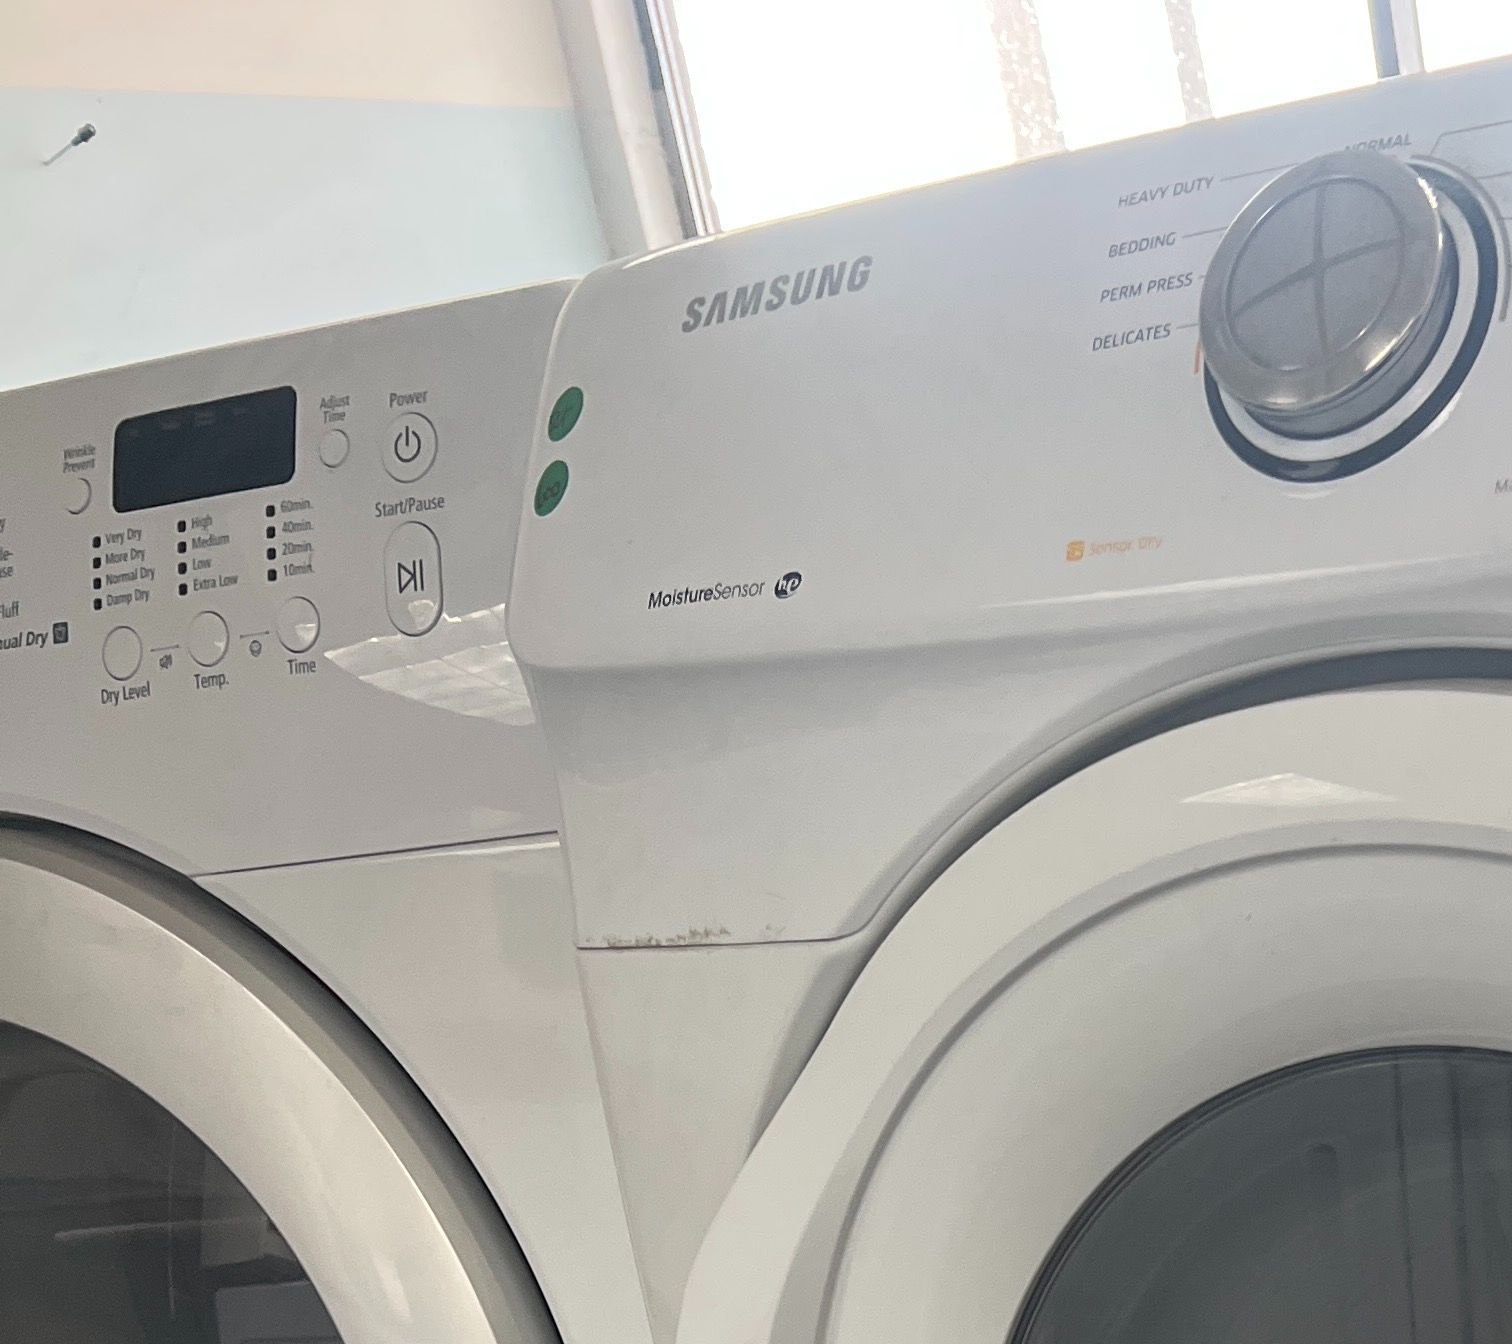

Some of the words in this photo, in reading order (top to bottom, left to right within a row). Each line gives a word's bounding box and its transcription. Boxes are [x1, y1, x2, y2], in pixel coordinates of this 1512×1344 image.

[1118, 186, 1169, 208] HEAVY
[1173, 176, 1214, 196] DUTY
[1108, 232, 1176, 258] BEDDING
[682, 255, 873, 333] SAMSUNG
[1100, 282, 1142, 303] PERM
[1147, 272, 1193, 294] PRESS
[1092, 323, 1171, 351] DELICATES
[389, 391, 428, 407] Power
[375, 496, 445, 517] Start/Pause
[105, 532, 124, 544] Very
[127, 528, 142, 541] Dry
[106, 553, 127, 565] More
[130, 549, 145, 561] Dry
[192, 558, 211, 570] Low
[106, 572, 137, 585] Normal
[140, 568, 155, 581] Dry
[193, 577, 216, 591] Extra
[219, 575, 238, 587] Low
[135, 589, 150, 602] Dry
[648, 581, 766, 609] MoistureSensor
[26, 631, 48, 649] Dry
[288, 658, 316, 674] Time
[194, 674, 229, 690] Temp.
[101, 688, 120, 706] Dry
[122, 681, 150, 700] Level
